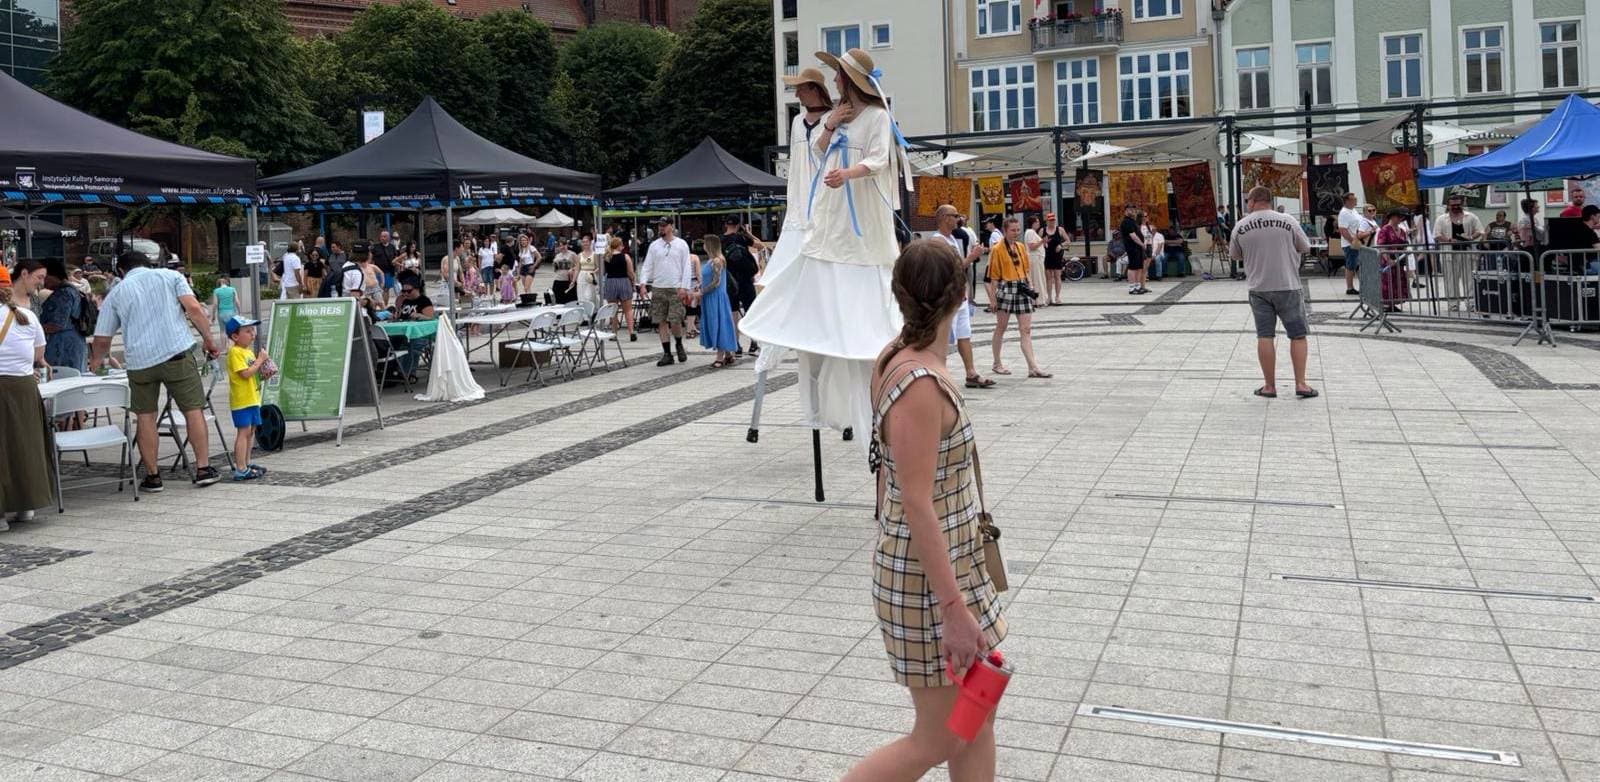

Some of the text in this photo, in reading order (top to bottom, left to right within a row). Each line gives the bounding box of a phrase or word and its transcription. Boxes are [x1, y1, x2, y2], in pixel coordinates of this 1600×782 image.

[72, 174, 93, 183] Kultury
[1238, 218, 1292, 235] California
[299, 306, 318, 316] kino
[320, 305, 342, 315] REJS
